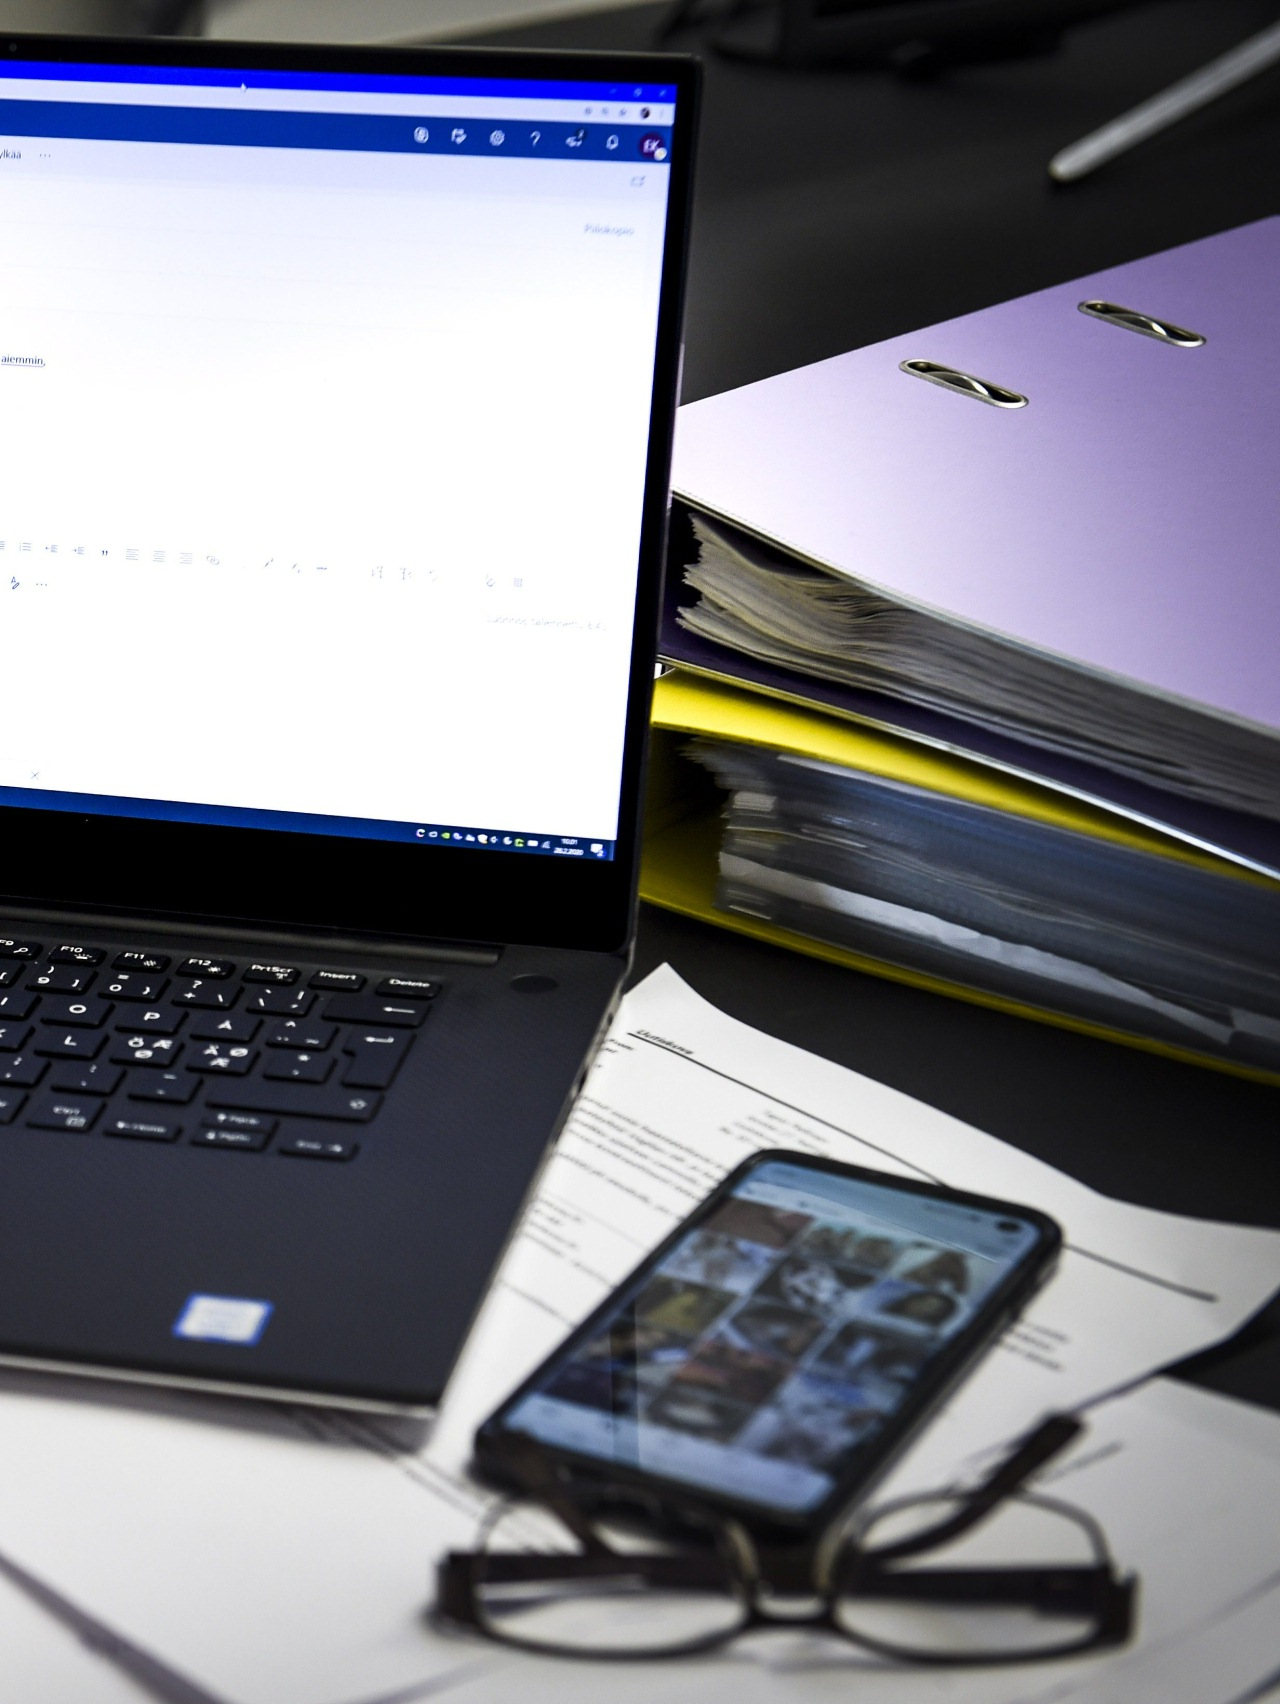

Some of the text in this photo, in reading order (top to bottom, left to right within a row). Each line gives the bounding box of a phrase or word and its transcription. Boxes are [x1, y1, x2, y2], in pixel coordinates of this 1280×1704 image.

[124, 952, 144, 960] F11
[188, 958, 212, 966] F12
[251, 964, 294, 973] PrtScr
[320, 971, 357, 981] Insert
[389, 978, 431, 988] Delete
[69, 1004, 87, 1014] O
[144, 1012, 161, 1021] P
[64, 1036, 77, 1046] L
